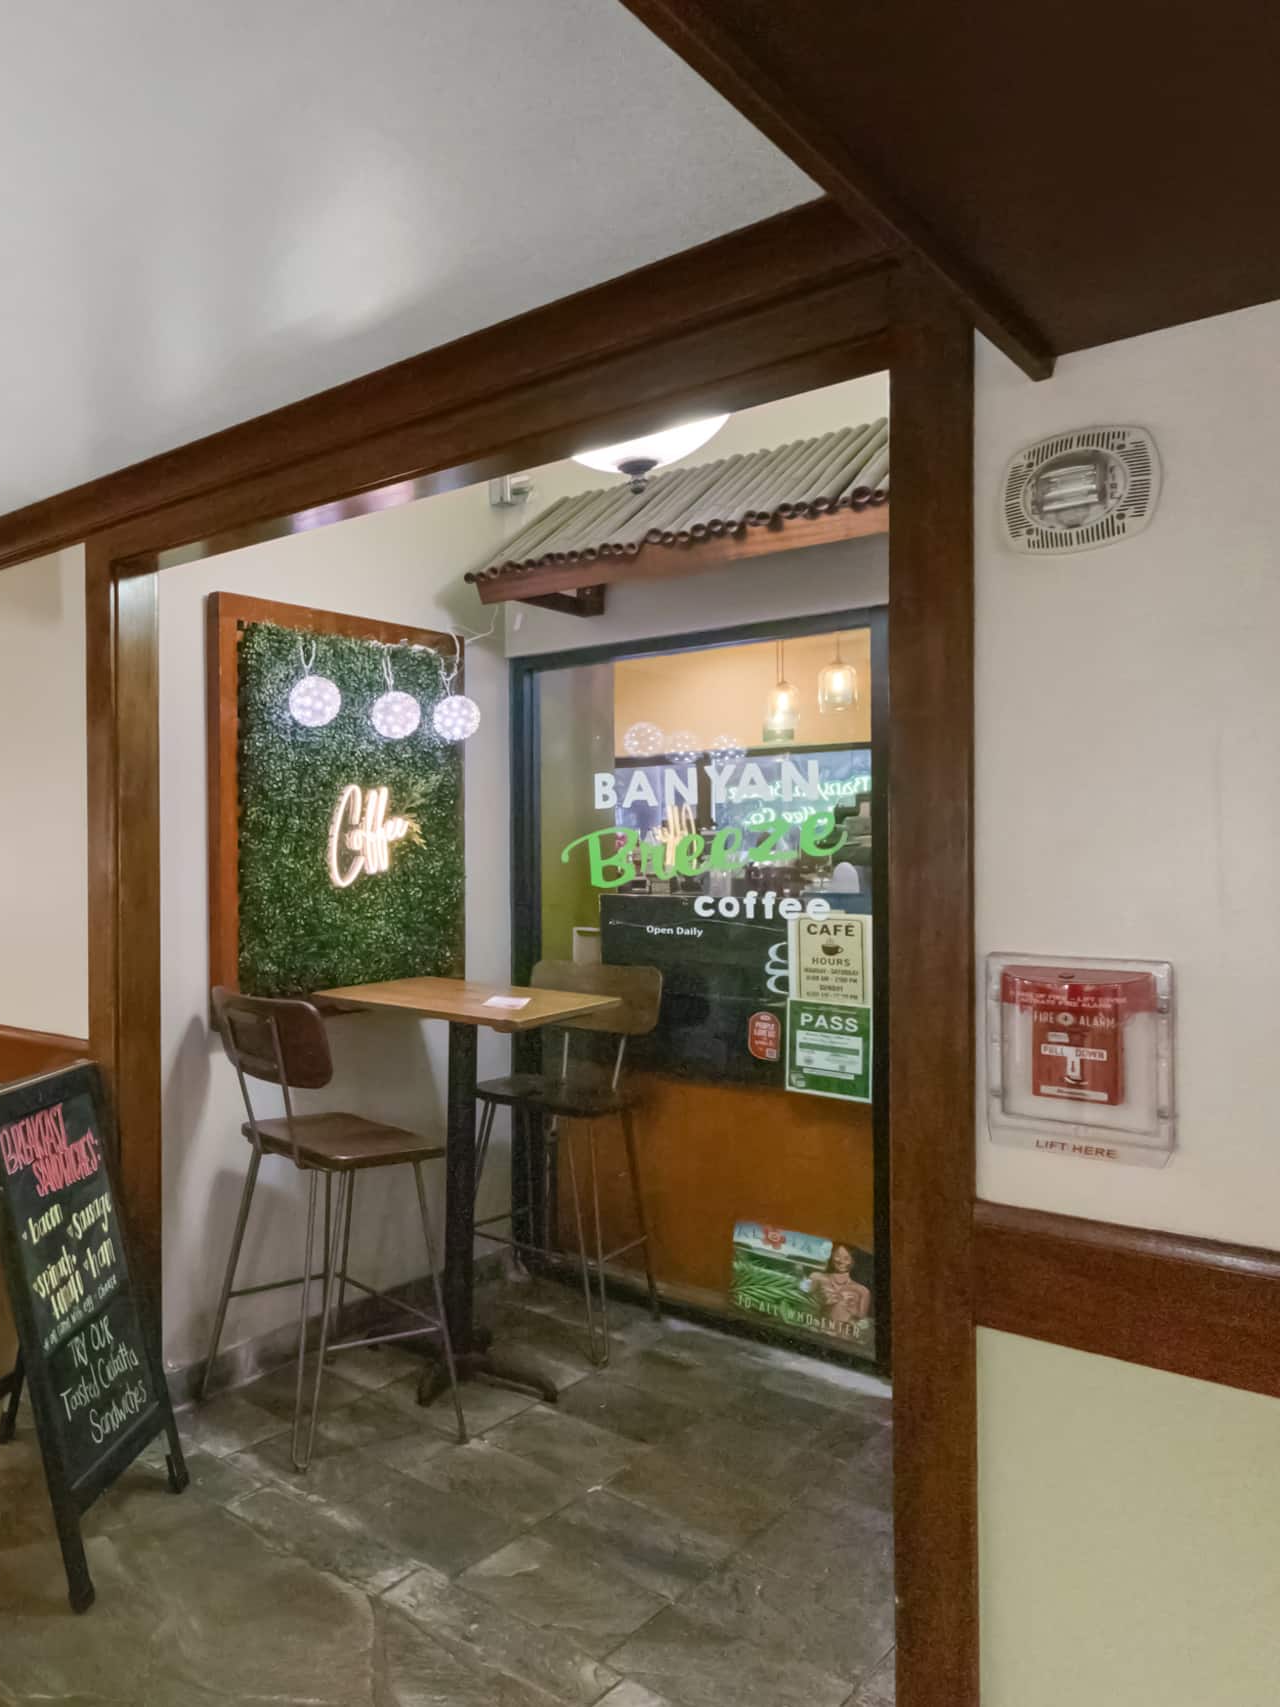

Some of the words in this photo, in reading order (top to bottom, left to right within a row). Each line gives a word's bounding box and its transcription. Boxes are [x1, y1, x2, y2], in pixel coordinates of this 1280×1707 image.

[593, 759, 820, 810] BANYAN
[561, 810, 849, 889] Breeze
[693, 890, 832, 920] coffee
[645, 924, 674, 936] Open
[676, 926, 704, 938] Daily
[811, 957, 851, 967] HOURS
[800, 1012, 859, 1033] PASS
[1034, 1010, 1054, 1024] FIRE
[1079, 1013, 1116, 1030] ALARM
[1035, 1139, 1067, 1152] LIFT
[1072, 1145, 1118, 1159] HERE
[28, 1203, 64, 1245] bacon
[72, 1191, 111, 1241] sausage
[86, 1237, 117, 1278] ham
[67, 1331, 89, 1368] TRY
[90, 1315, 115, 1351] OUR
